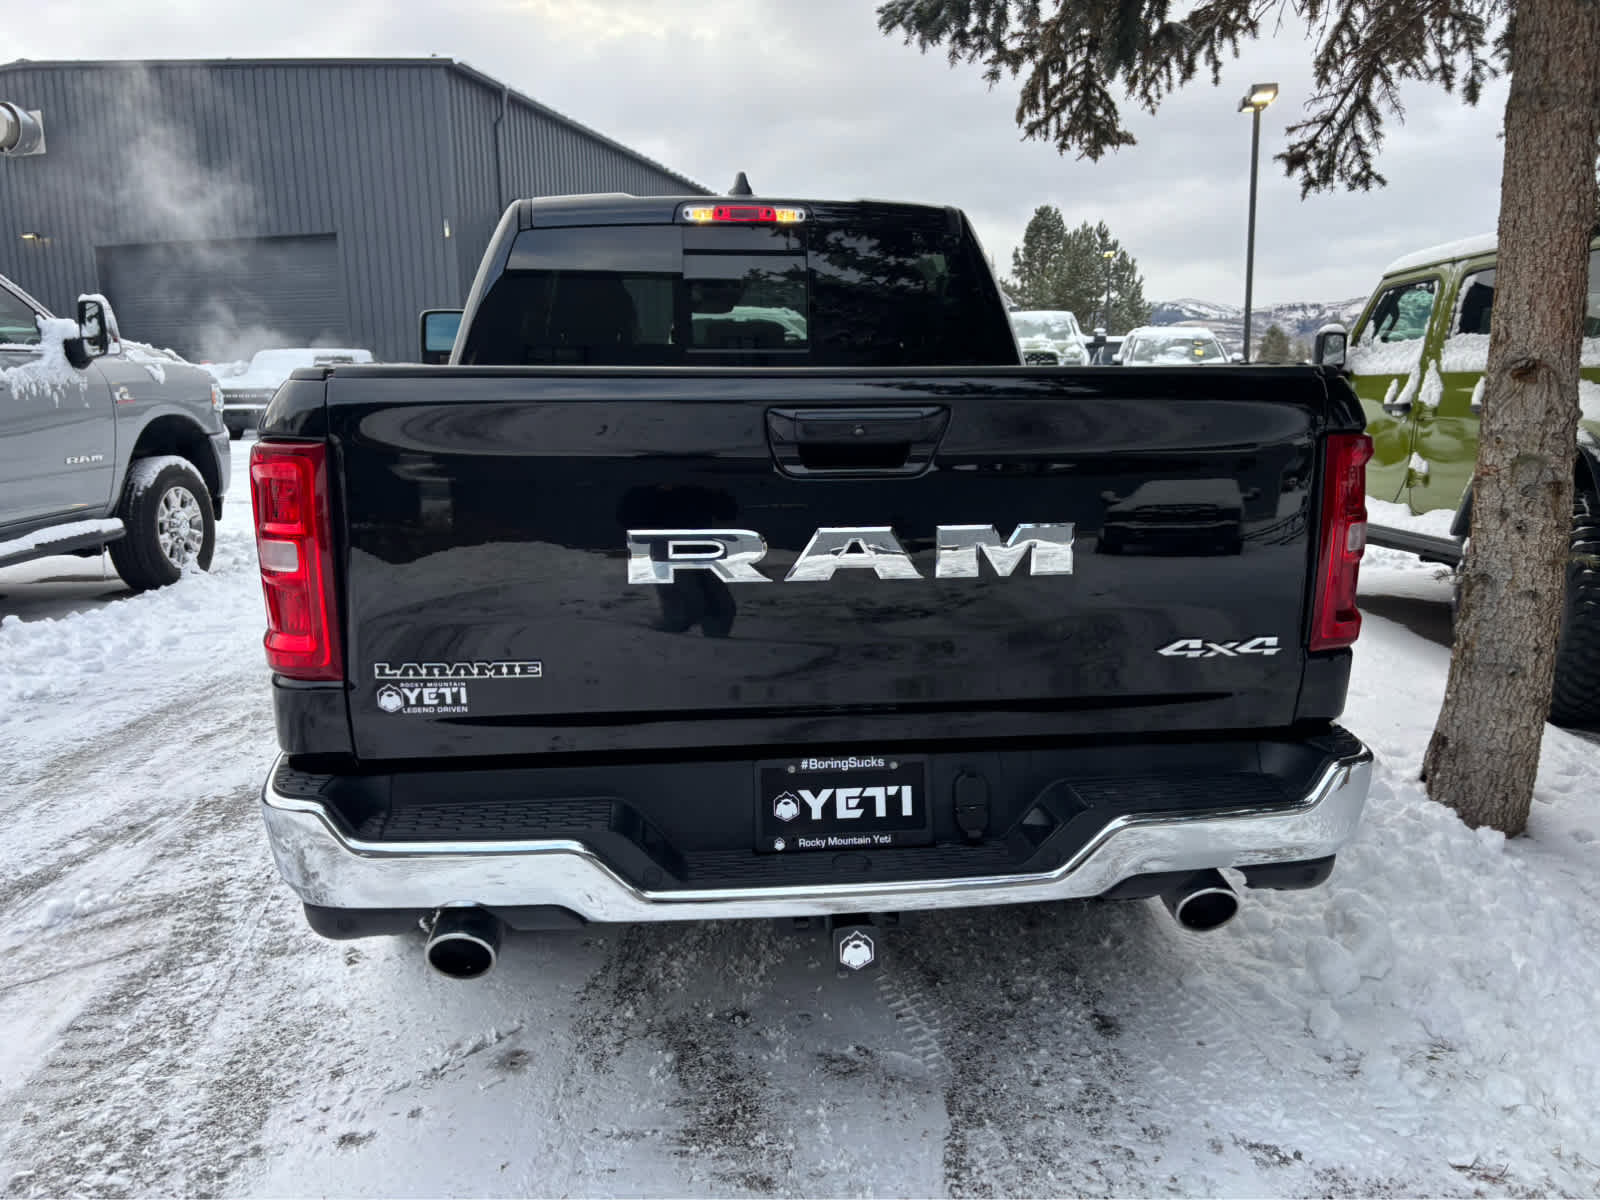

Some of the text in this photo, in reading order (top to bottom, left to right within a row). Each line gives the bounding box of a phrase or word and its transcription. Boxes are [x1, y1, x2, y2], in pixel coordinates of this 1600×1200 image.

[65, 455, 104, 465] RAM
[627, 522, 1075, 584] RAM
[1157, 636, 1283, 658] 4x4
[374, 662, 542, 679] LARAMIE
[402, 687, 468, 705] YETI
[437, 706, 468, 714] DRIVEN
[801, 757, 885, 771] #BoringSucks
[797, 785, 912, 820] YETI
[798, 834, 892, 848] Rocky Mountain Yeti
